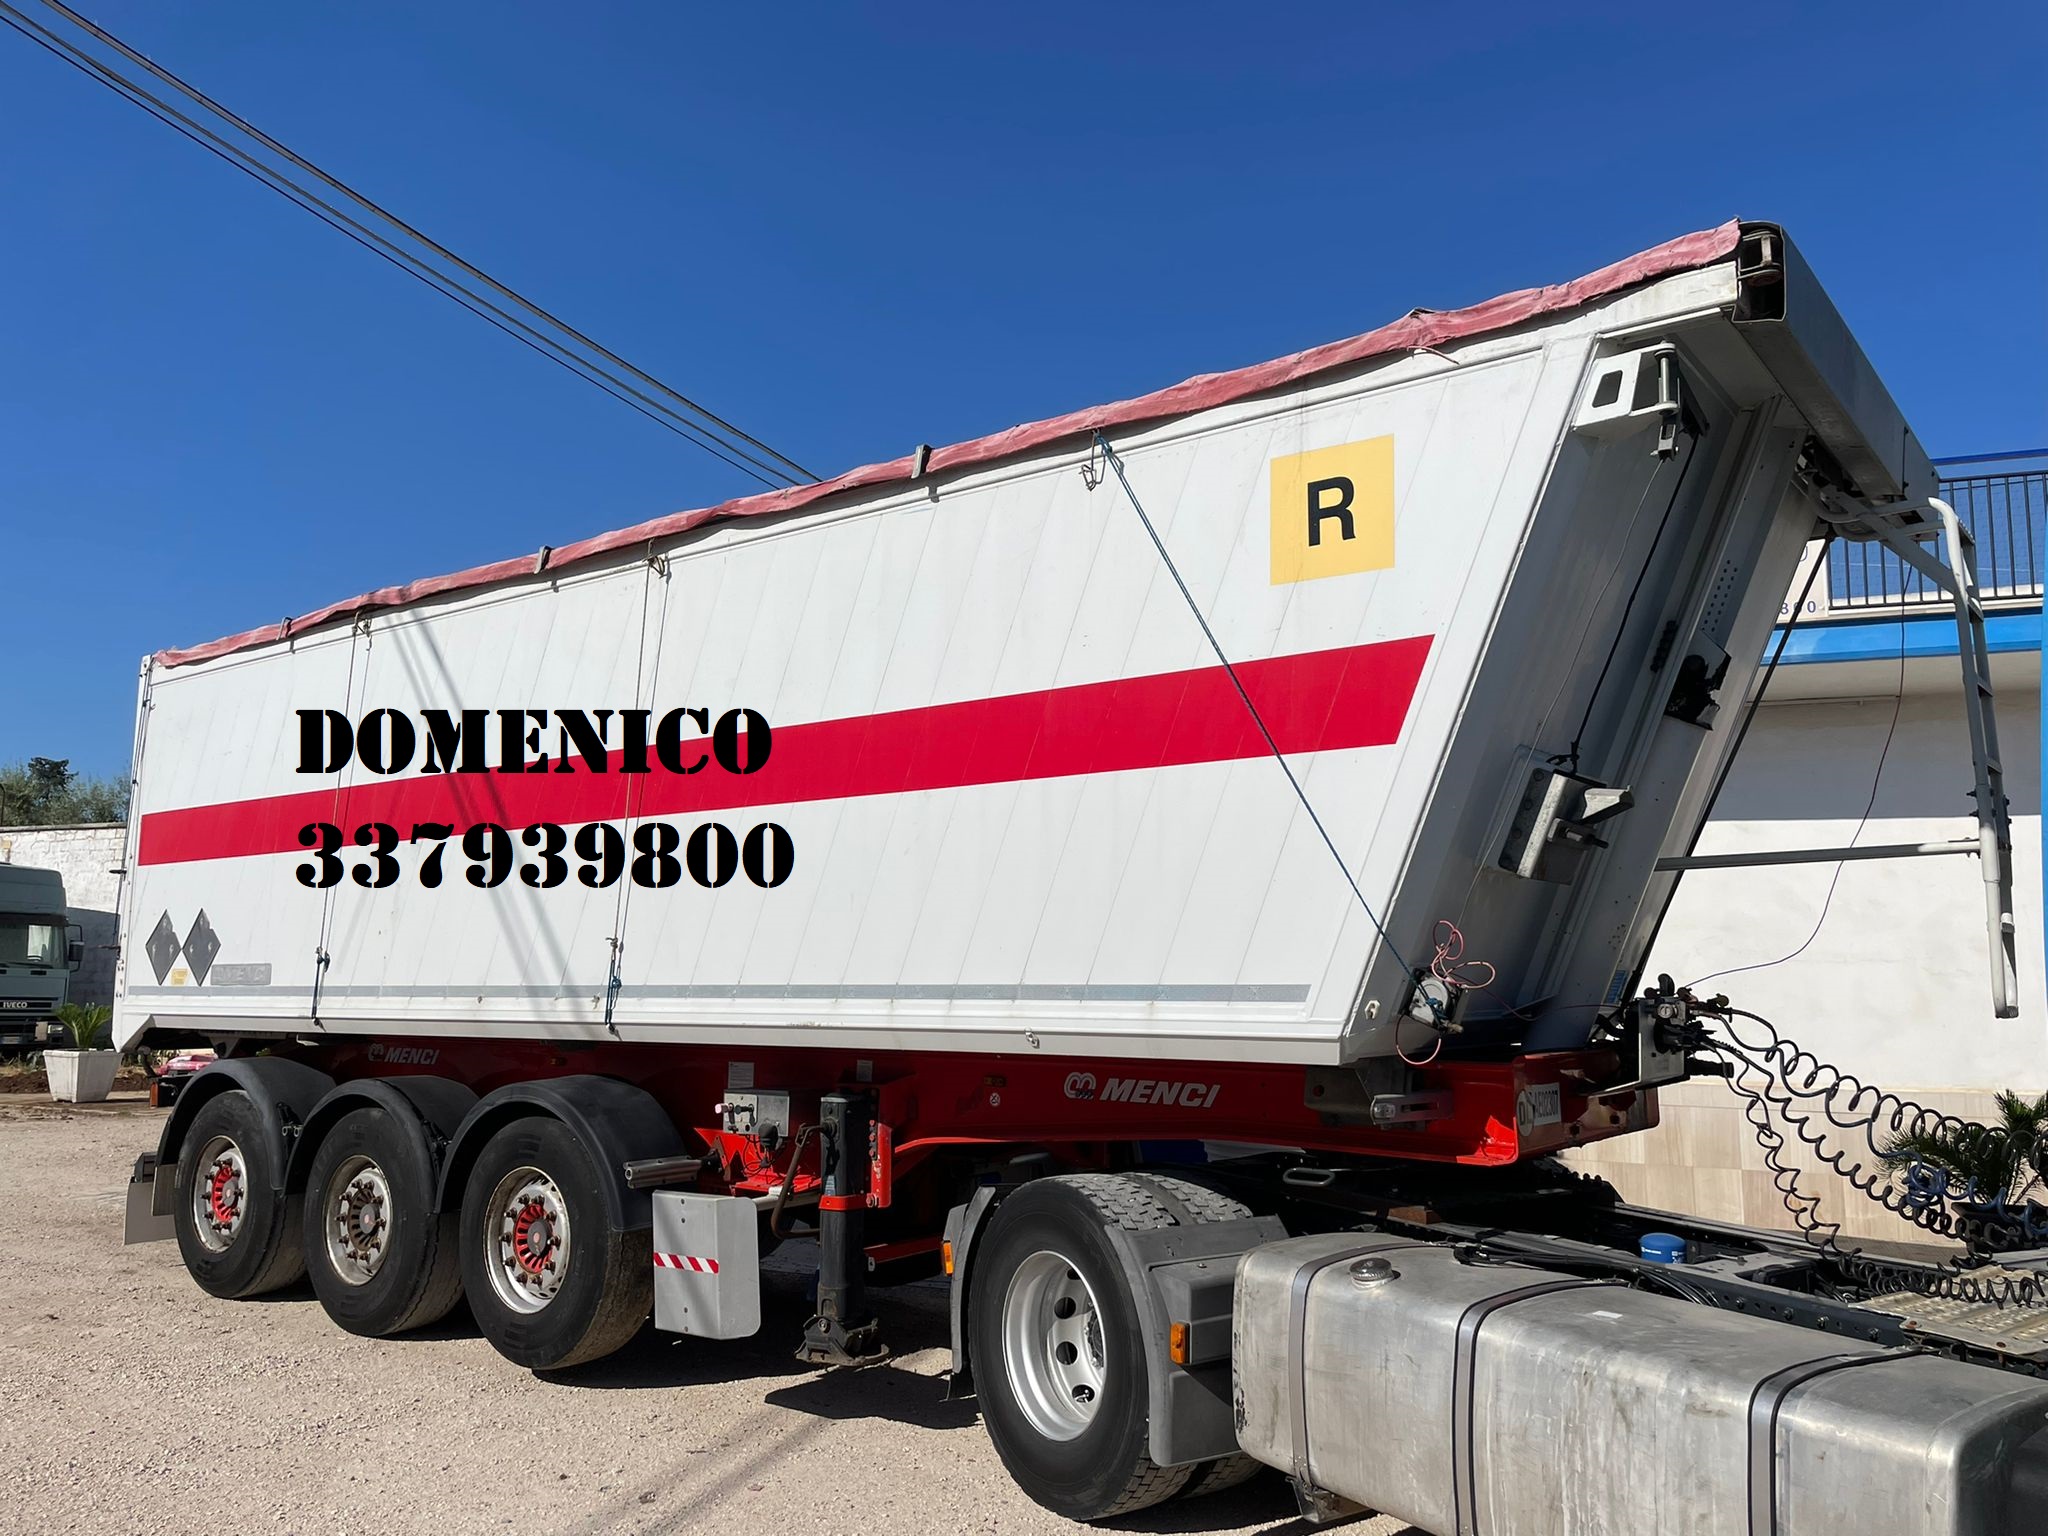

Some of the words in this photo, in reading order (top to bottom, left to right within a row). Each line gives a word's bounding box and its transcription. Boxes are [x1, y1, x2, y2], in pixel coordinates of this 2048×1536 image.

[1307, 476, 1356, 547] R
[3, 1001, 28, 1009] IVECO
[384, 1047, 440, 1065] MENCI
[1099, 1078, 1221, 1108] MENCI
